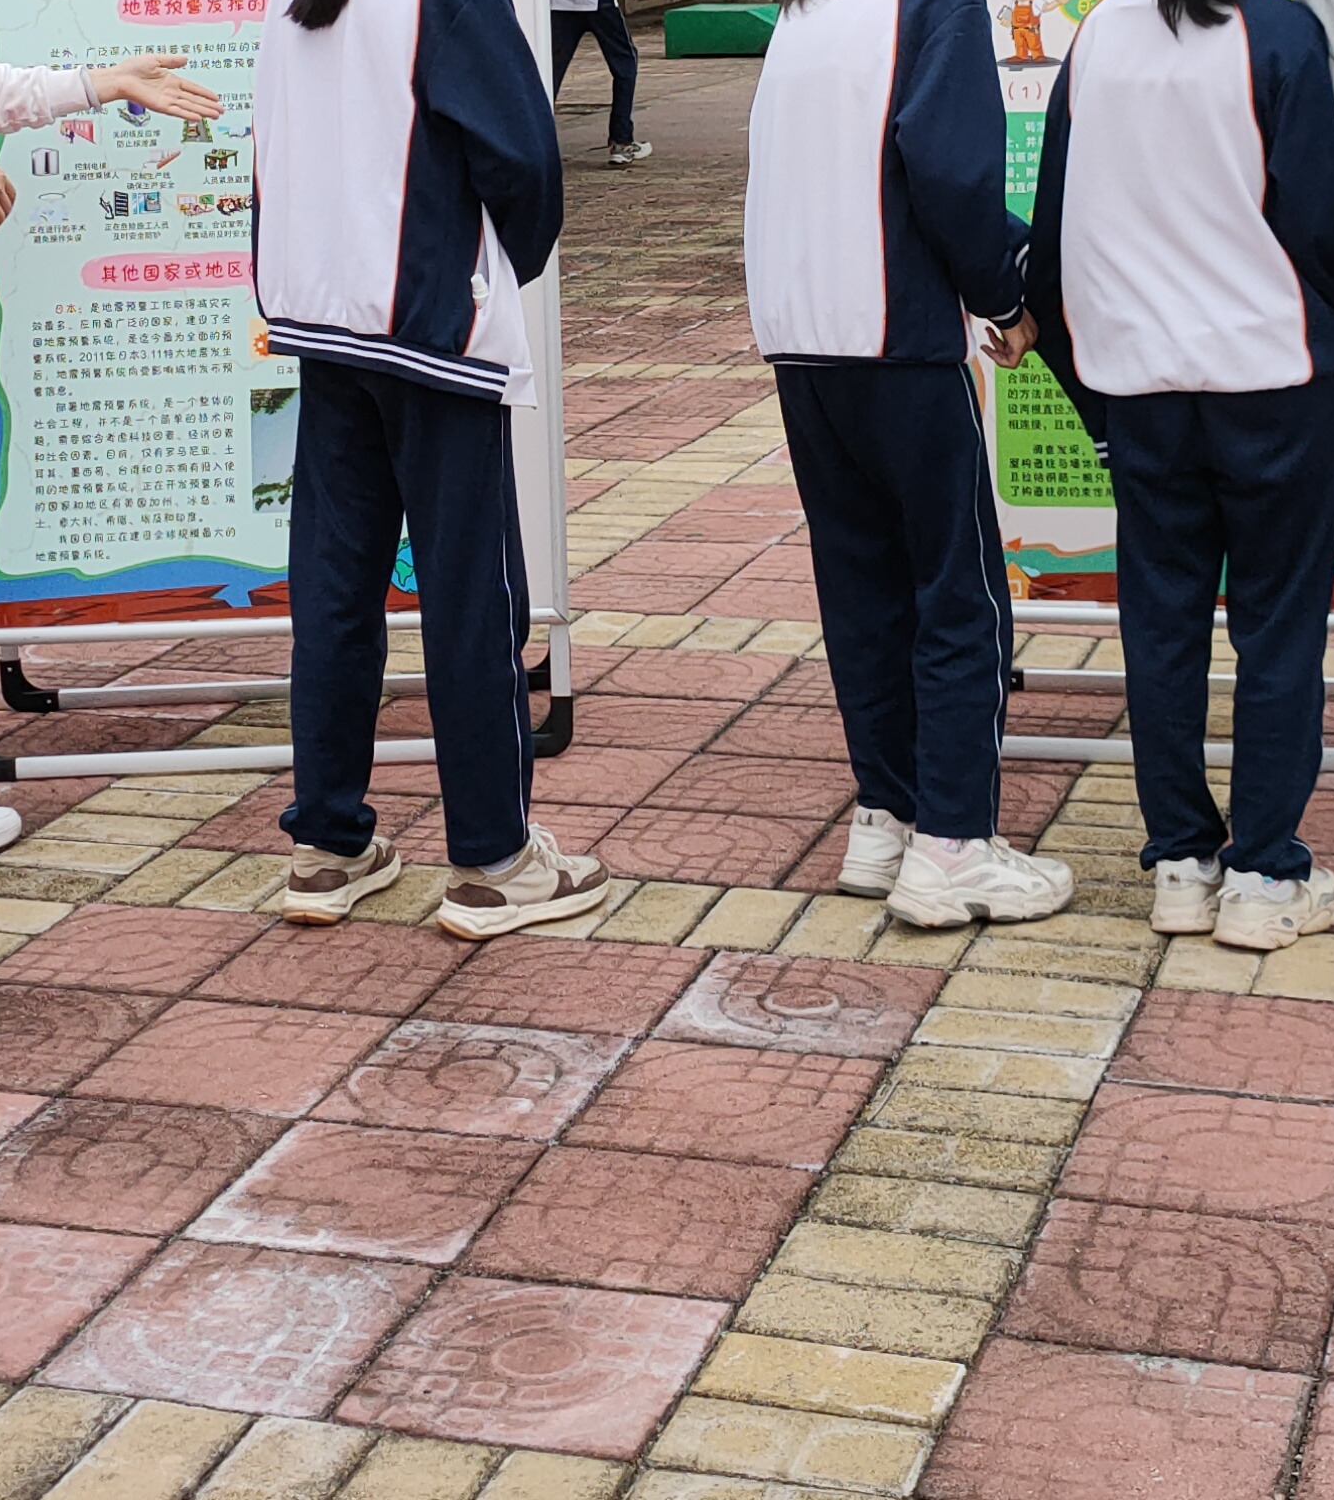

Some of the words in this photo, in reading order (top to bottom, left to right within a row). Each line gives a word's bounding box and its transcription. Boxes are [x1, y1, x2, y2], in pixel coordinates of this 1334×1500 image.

[182, 56, 257, 70] 体现地震预警
[183, 229, 253, 240] 密集场所及时安全
[101, 260, 253, 284] 其他国家或地区
[276, 364, 301, 377] 日本
[1007, 372, 1058, 385] 合面的马
